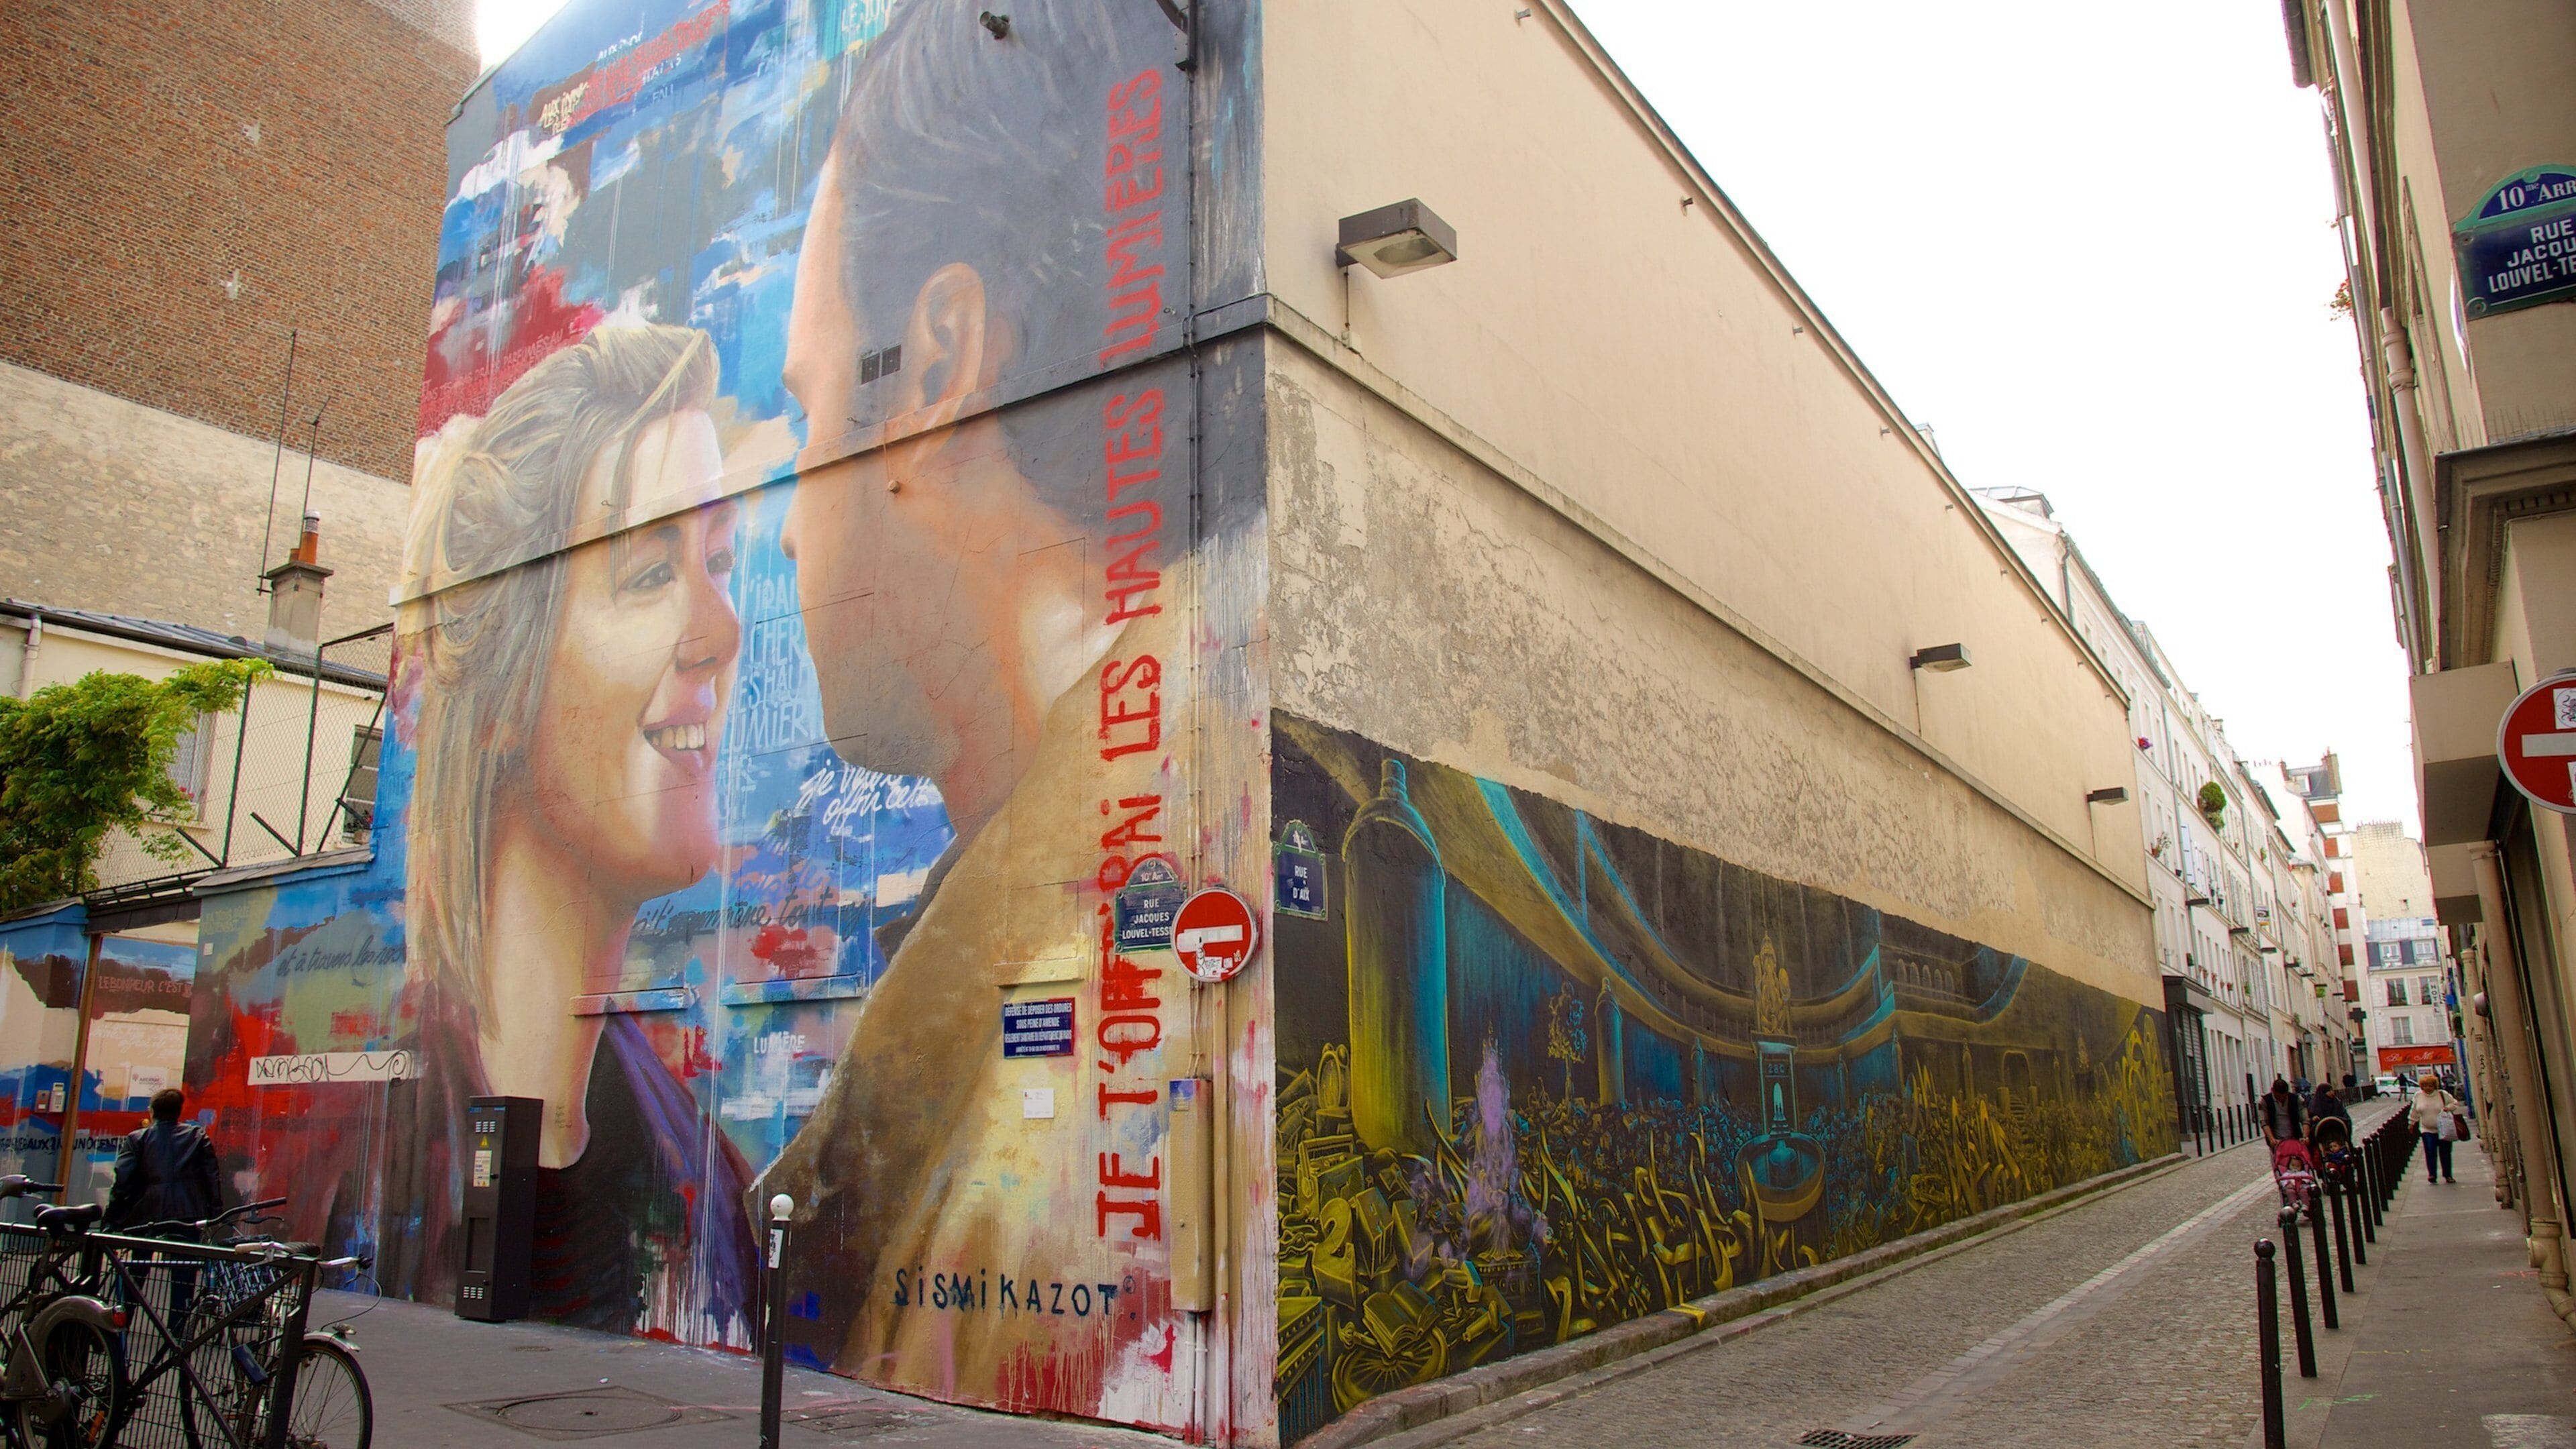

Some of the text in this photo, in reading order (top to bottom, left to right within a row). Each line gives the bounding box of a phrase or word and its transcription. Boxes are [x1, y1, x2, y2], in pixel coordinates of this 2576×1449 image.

[2530, 219, 2574, 244] RUE
[2506, 235, 2576, 268] JACQU
[2488, 255, 2576, 294] LOUVEL-TE
[1104, 388, 1165, 626] HAUTES
[1099, 653, 1162, 762] LES
[1294, 865, 1308, 879] RUE
[1144, 898, 1160, 909] RUE
[1293, 886, 1310, 902] D'AIX
[1133, 911, 1170, 924] JACQUES
[1045, 1004, 1053, 1014] DES
[1096, 1151, 1163, 1242] JE
